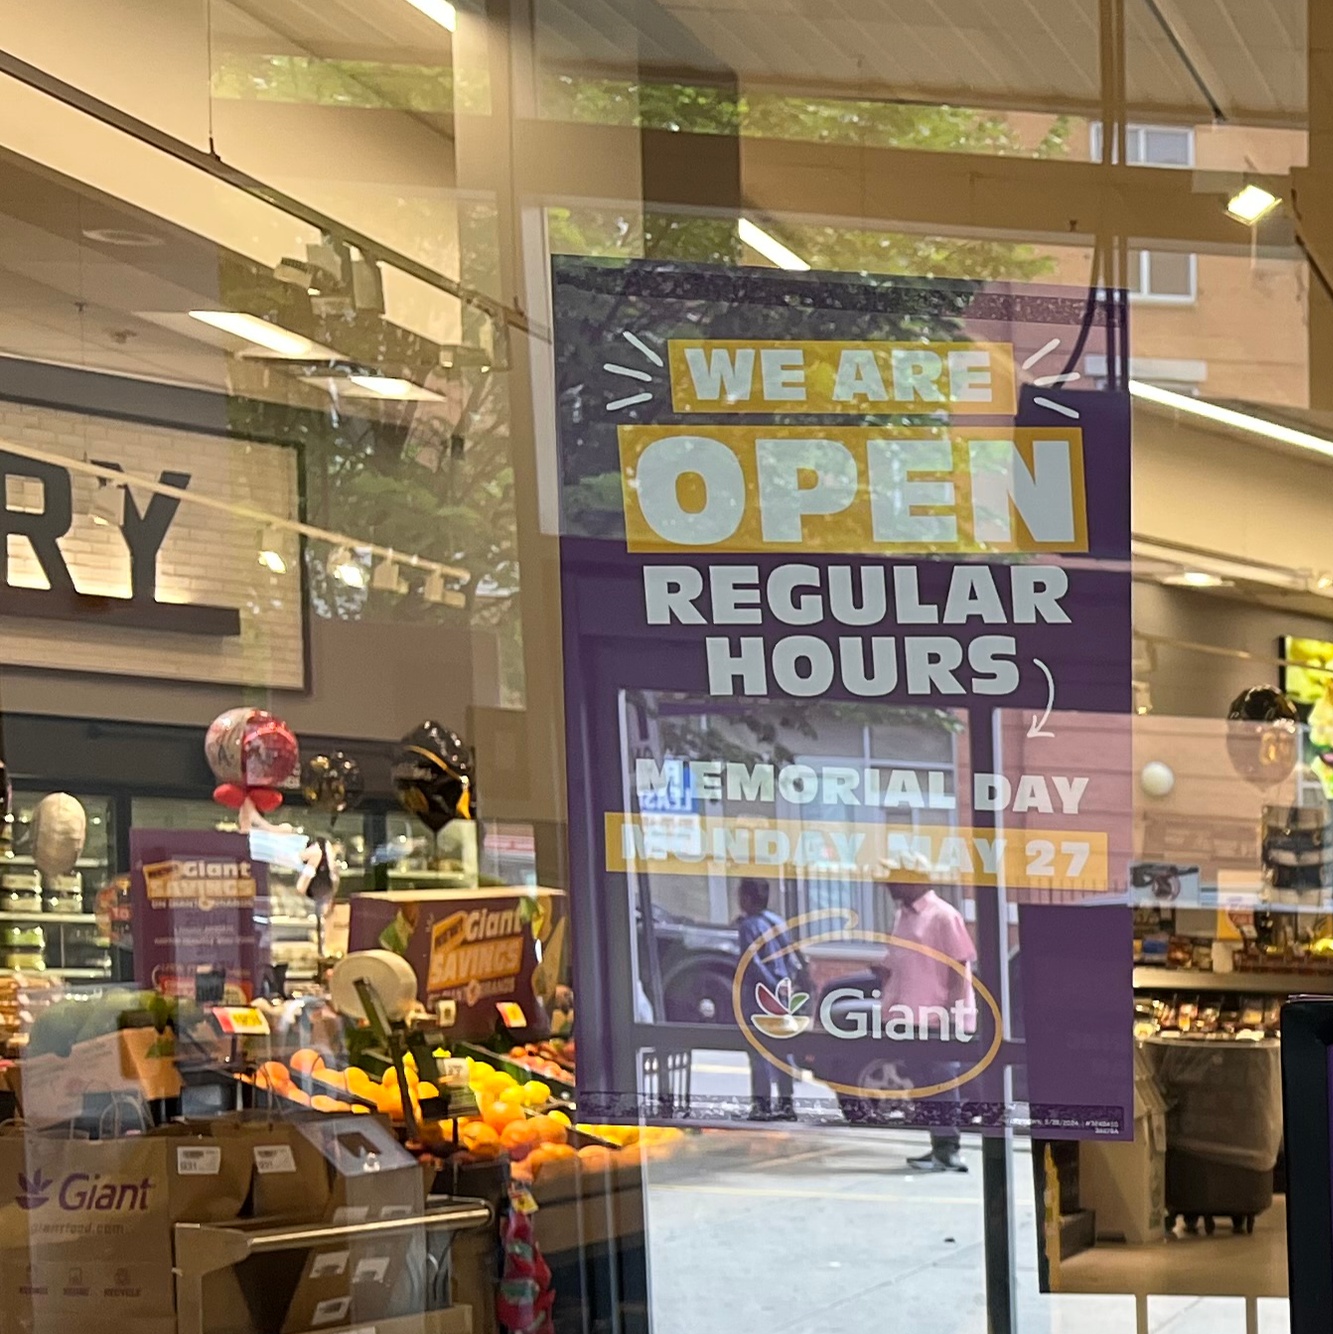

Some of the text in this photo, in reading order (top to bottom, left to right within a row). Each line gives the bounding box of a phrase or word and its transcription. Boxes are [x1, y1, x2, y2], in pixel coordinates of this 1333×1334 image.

[685, 348, 991, 402] WE ARE
[635, 435, 1075, 545] OPEN
[644, 565, 1071, 626] REGULAR
[706, 636, 1020, 697] HOURS
[635, 758, 1089, 815] MEMORIAL DAY
[621, 823, 1091, 877] MONDAY MAY 27
[819, 987, 978, 1044] Giant
[59, 1172, 152, 1211] Giant
